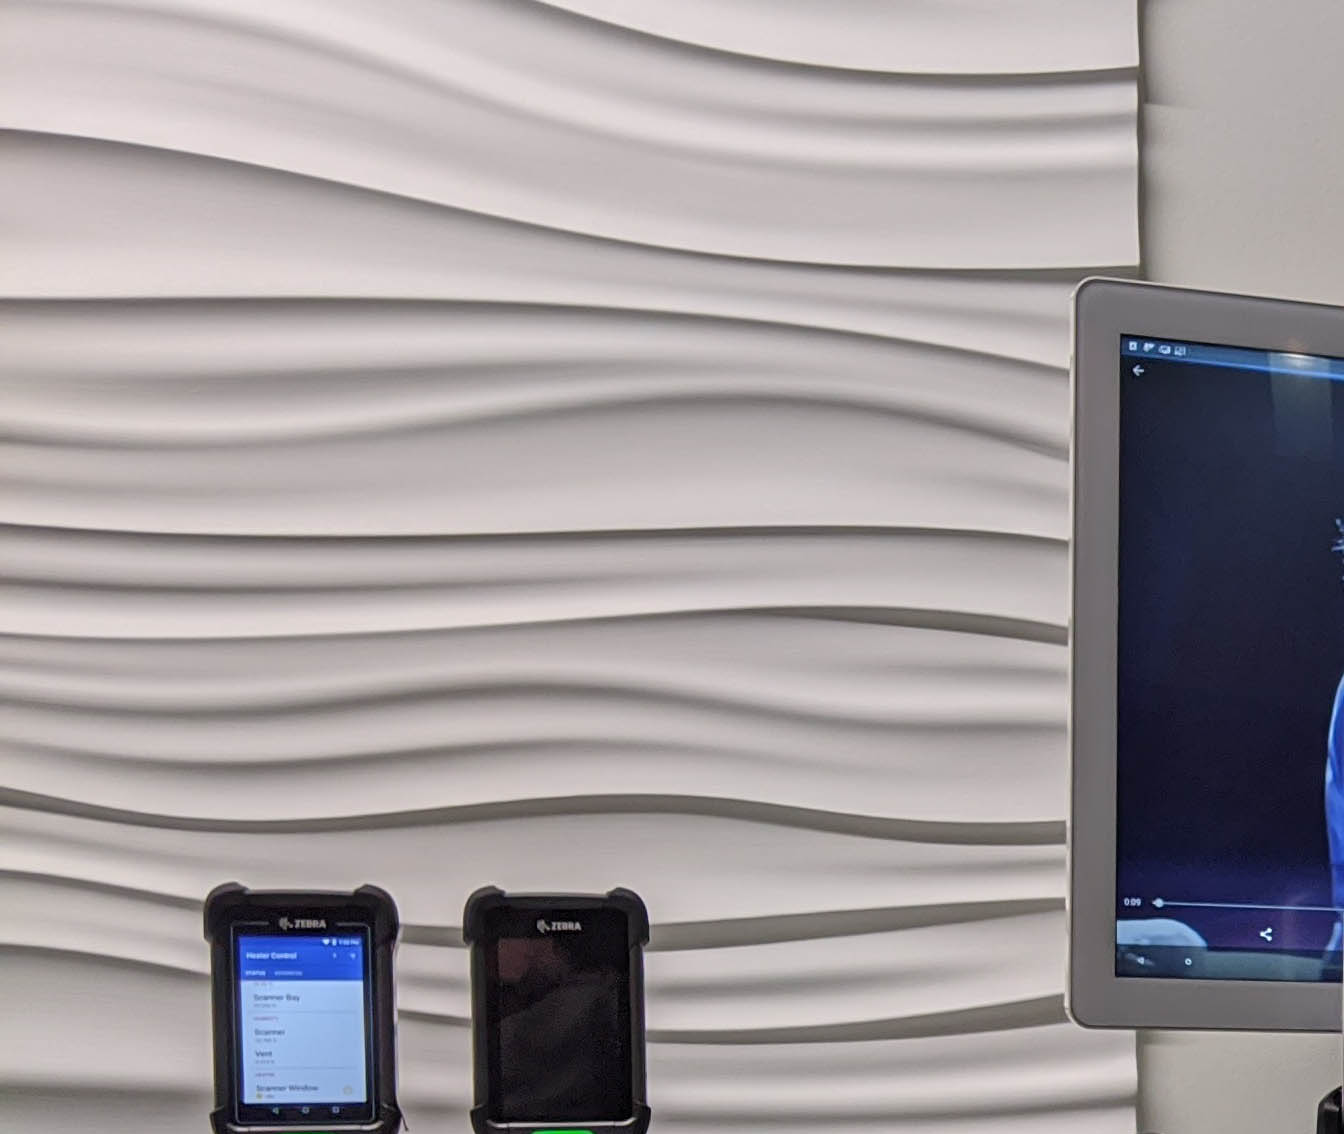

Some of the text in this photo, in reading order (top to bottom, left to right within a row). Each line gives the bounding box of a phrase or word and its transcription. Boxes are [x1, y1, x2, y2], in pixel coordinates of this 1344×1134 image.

[293, 919, 327, 929] ZEBRA
[551, 921, 582, 931] ZEBRA
[286, 994, 300, 1002] Bay
